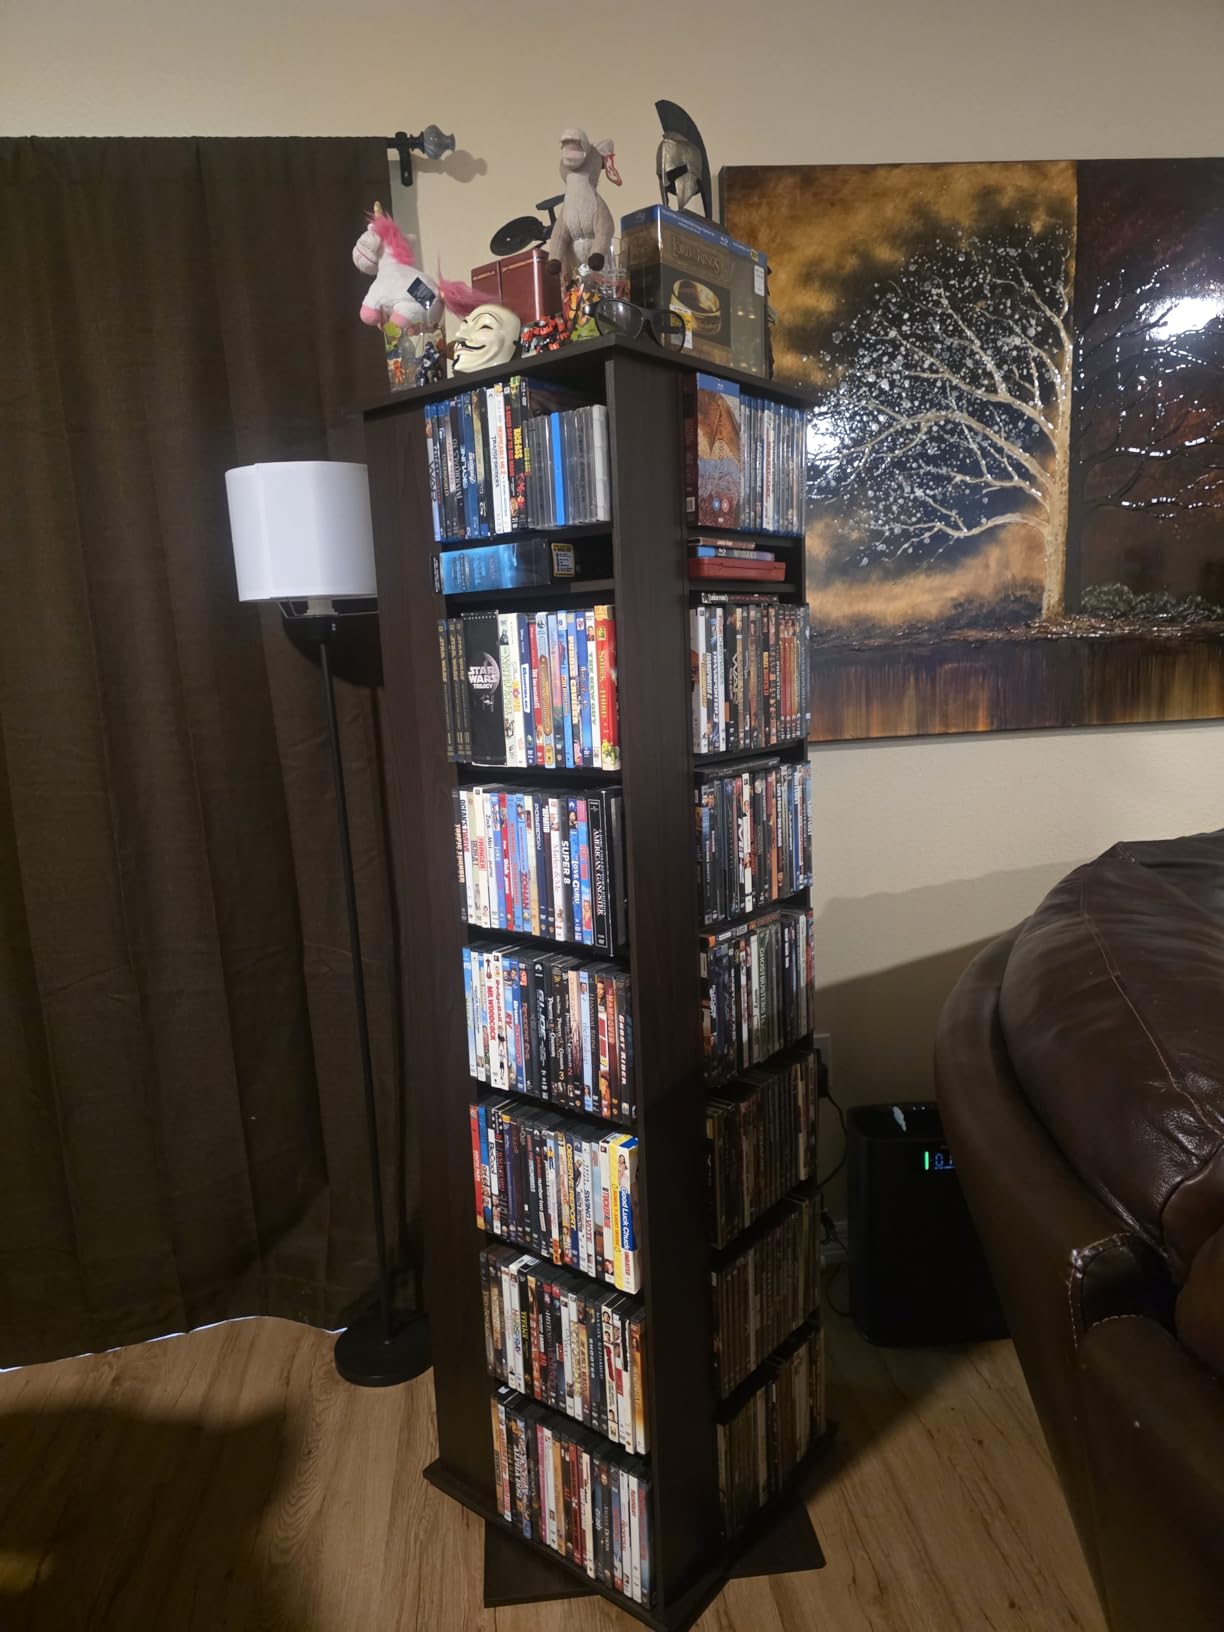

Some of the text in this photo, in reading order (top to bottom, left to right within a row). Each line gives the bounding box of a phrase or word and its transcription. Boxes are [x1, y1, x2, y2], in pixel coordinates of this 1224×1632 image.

[453, 450, 463, 499] IMMORTALS
[468, 665, 500, 675] STAR
[470, 675, 500, 685] WARS
[561, 840, 570, 875] SUPER
[593, 829, 604, 915] AMERICAN GANGSTER
[521, 872, 529, 909] ZOHAN
[487, 998, 496, 1041] WOODCOCK
[506, 1013, 513, 1029] RV
[606, 995, 616, 1044] HANGOVER
[620, 1051, 628, 1085] RIDER
[620, 1187, 631, 1249] Good Luck Chuck
